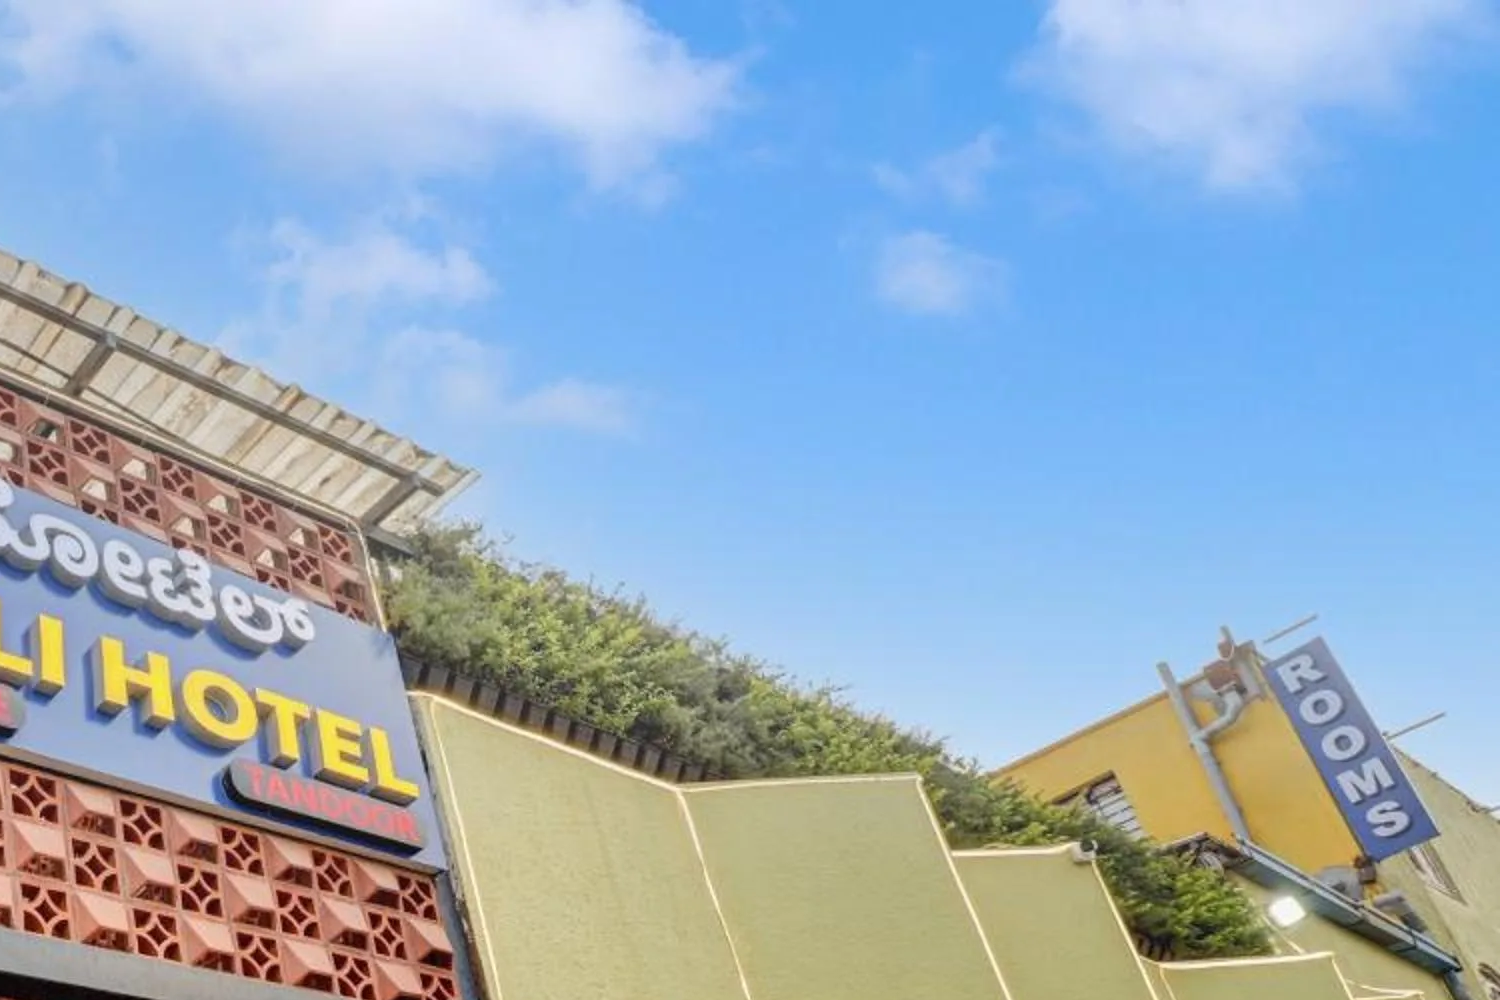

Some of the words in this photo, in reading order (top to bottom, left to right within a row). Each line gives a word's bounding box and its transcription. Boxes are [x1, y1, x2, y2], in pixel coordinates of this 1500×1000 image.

[96, 634, 422, 808] HOTEL
[243, 764, 422, 842] TANDOOR
[1275, 653, 1411, 838] ROOMS
